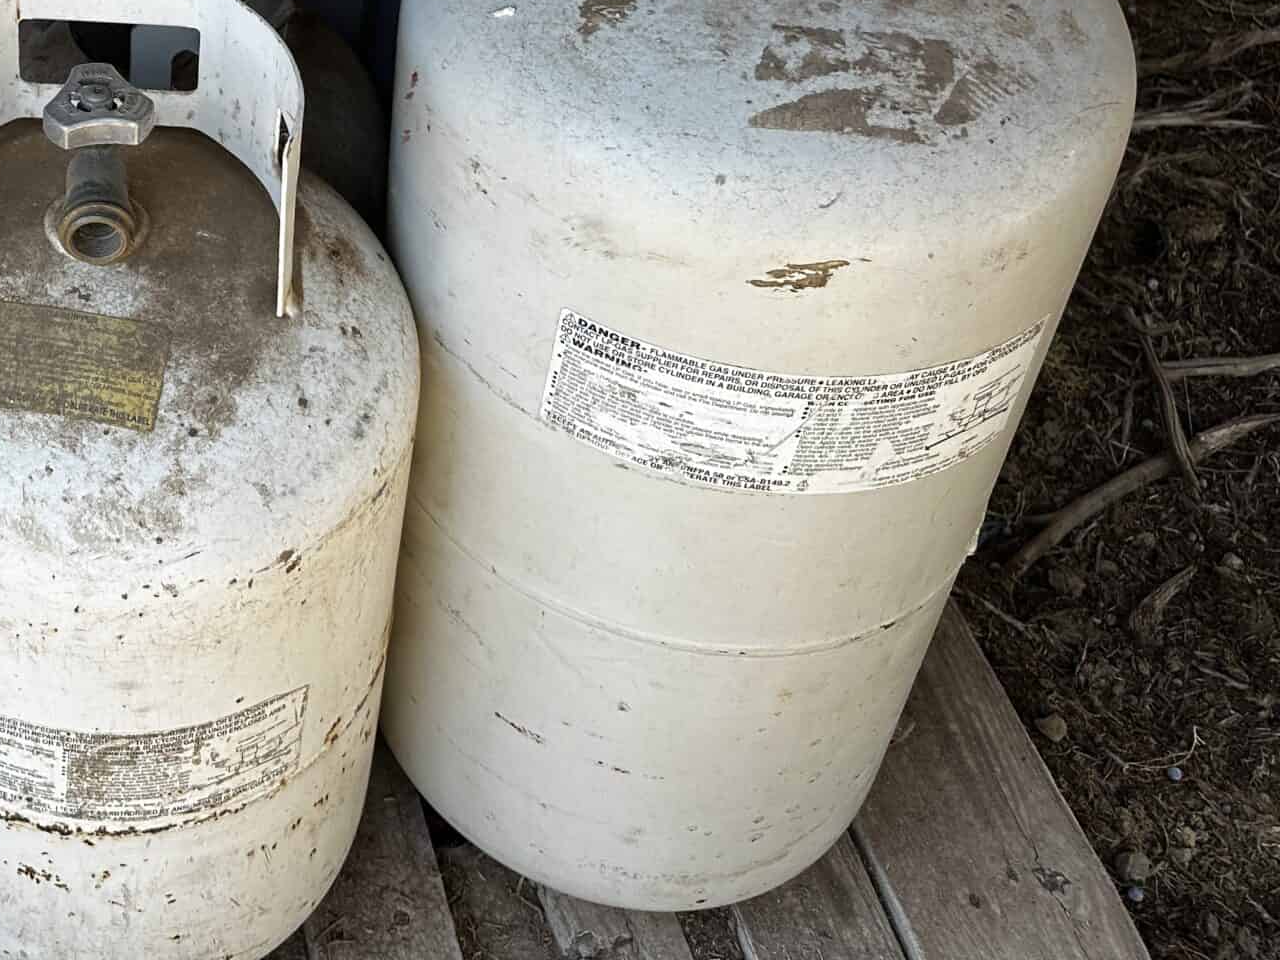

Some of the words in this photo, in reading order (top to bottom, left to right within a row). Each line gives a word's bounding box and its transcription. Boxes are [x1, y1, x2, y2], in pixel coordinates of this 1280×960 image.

[561, 324, 573, 336] DO
[575, 330, 591, 344] NOT
[593, 341, 609, 352] USE
[612, 349, 625, 359] OR
[627, 355, 657, 370] STORE
[658, 366, 704, 385] CYLINDER
[706, 380, 715, 388] IN
[774, 391, 813, 401] GARAGE
[881, 389, 904, 398] AREA
[912, 385, 925, 394] DO
[562, 318, 599, 340] CONTACT
[635, 350, 679, 369] SUPPLIER
[680, 365, 699, 375] FOR
[745, 379, 758, 387] OR
[760, 381, 806, 394] DISPOSAL
[845, 384, 888, 393] CYLINDER
[890, 382, 902, 390] OR
[904, 375, 937, 388] UNUSED
[650, 348, 707, 370] FLAMMABLE
[709, 365, 729, 375] GAS
[731, 370, 764, 382] UNDER
